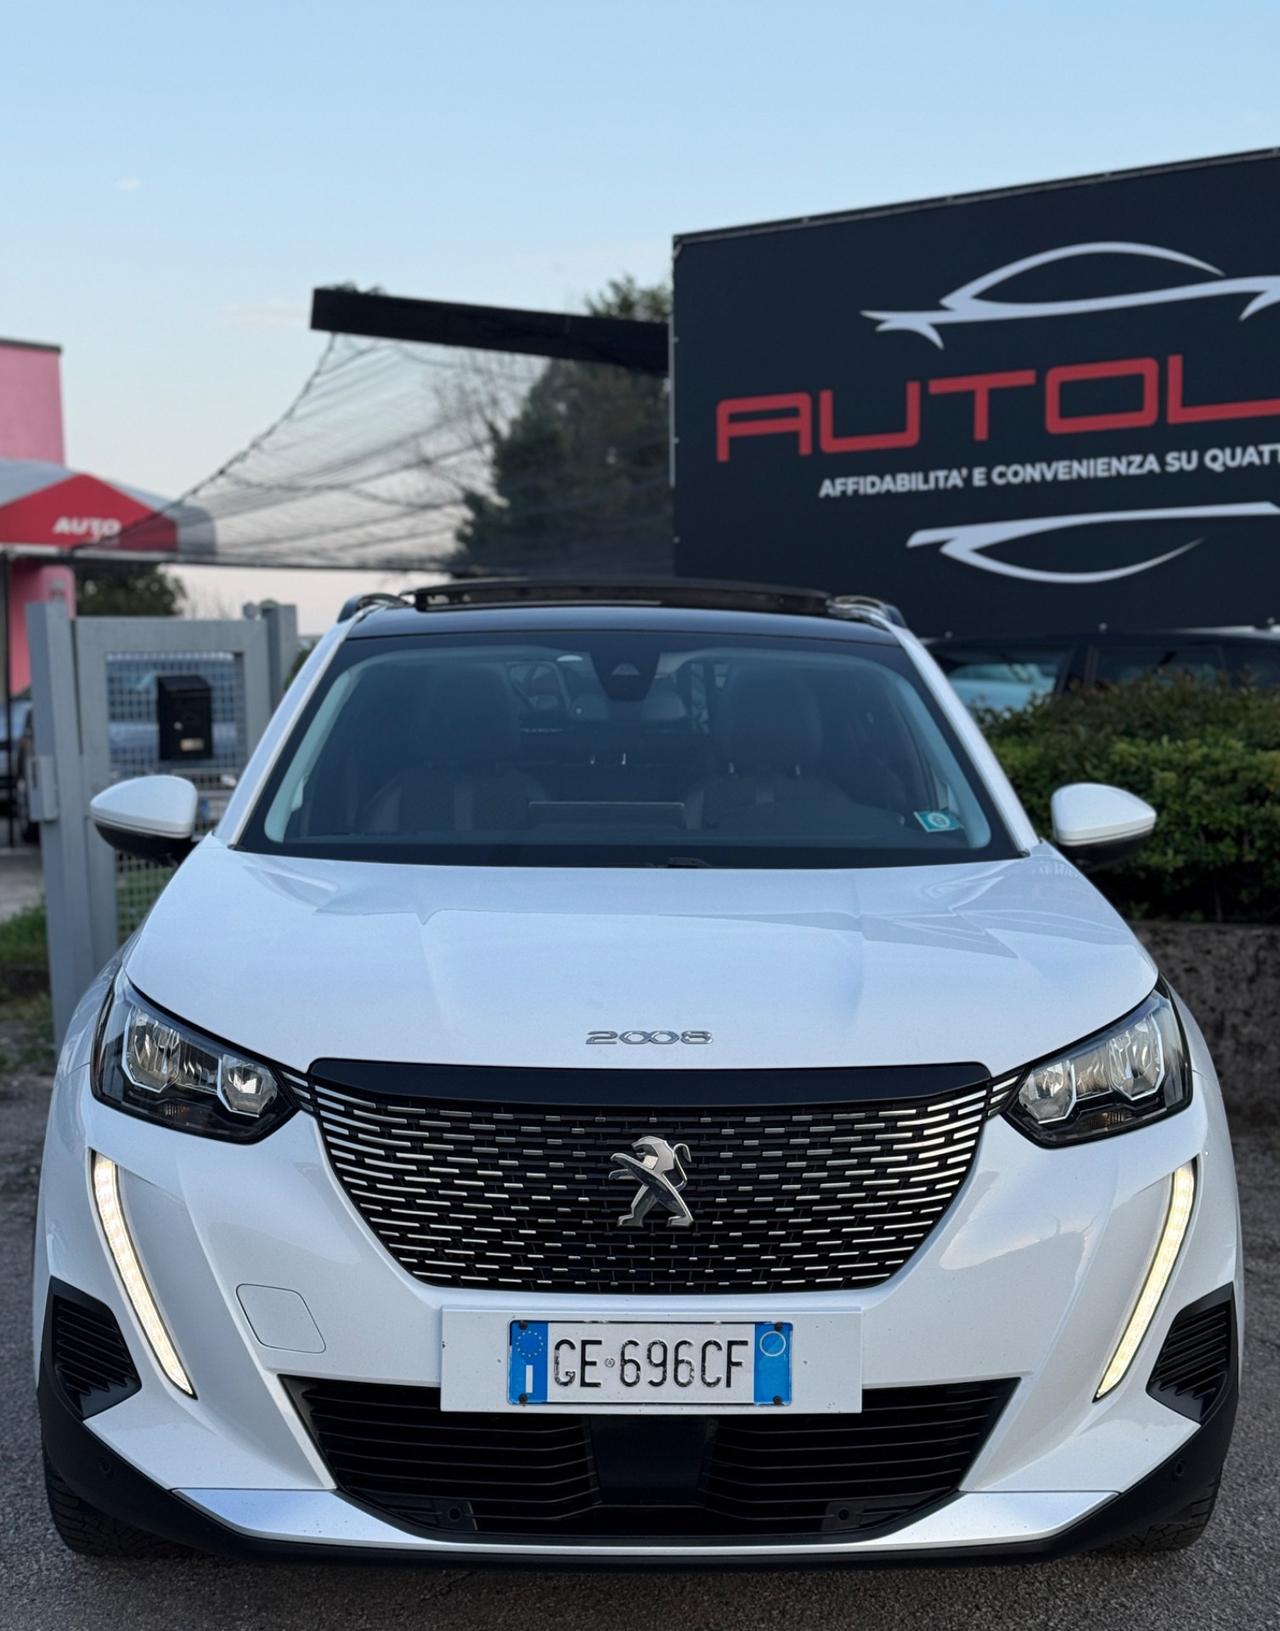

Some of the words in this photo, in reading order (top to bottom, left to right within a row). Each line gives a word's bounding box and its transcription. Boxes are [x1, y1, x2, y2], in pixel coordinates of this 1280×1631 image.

[716, 354, 1280, 462] AUTOL
[818, 467, 968, 498] AFFIDABILITA'
[972, 467, 988, 487] E
[990, 453, 1161, 486] CONVENIENZA
[1165, 450, 1199, 472] SU
[585, 1030, 713, 1045] 2008
[553, 1338, 603, 1388] GE
[619, 1339, 749, 1388] 696CF
